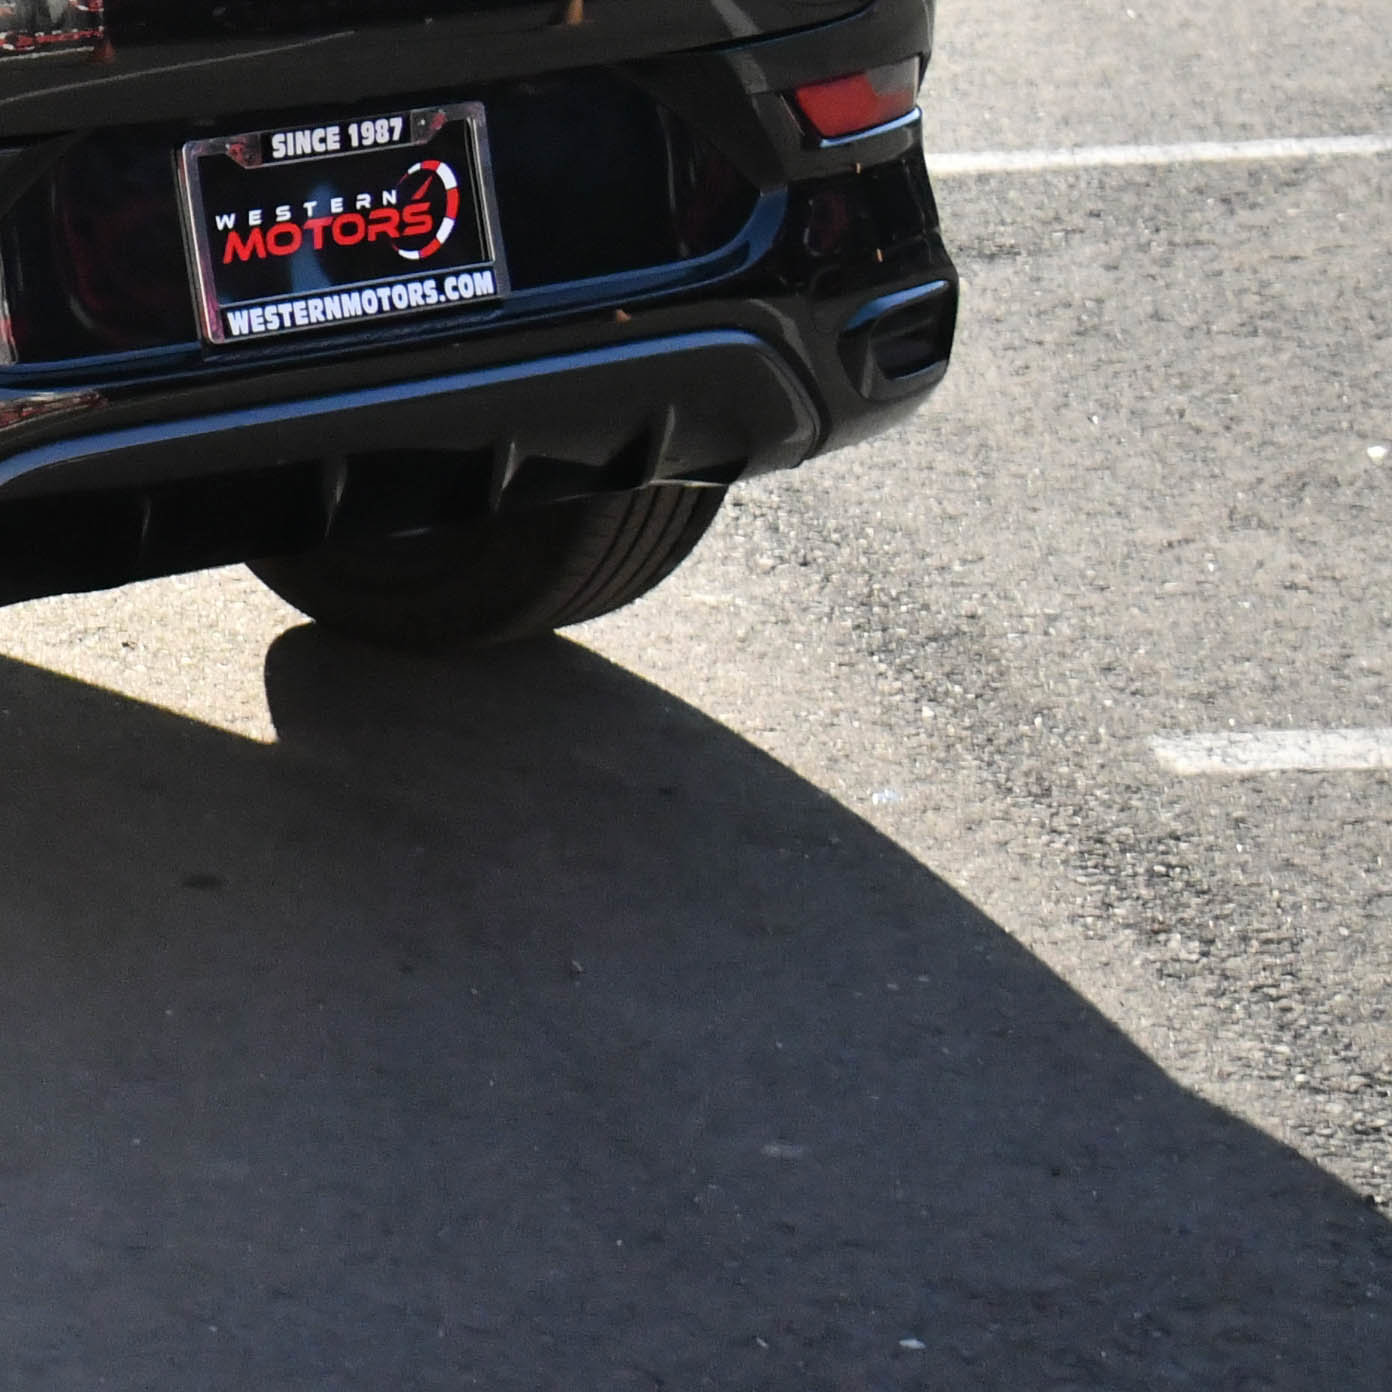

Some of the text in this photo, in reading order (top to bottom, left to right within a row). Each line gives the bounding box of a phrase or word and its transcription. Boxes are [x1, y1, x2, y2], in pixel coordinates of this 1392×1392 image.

[270, 116, 404, 159] SINCE 1987
[215, 188, 399, 231] WESTERN
[222, 201, 435, 265] MOTORS
[226, 270, 496, 337] WESTERNMOTORS.COM
